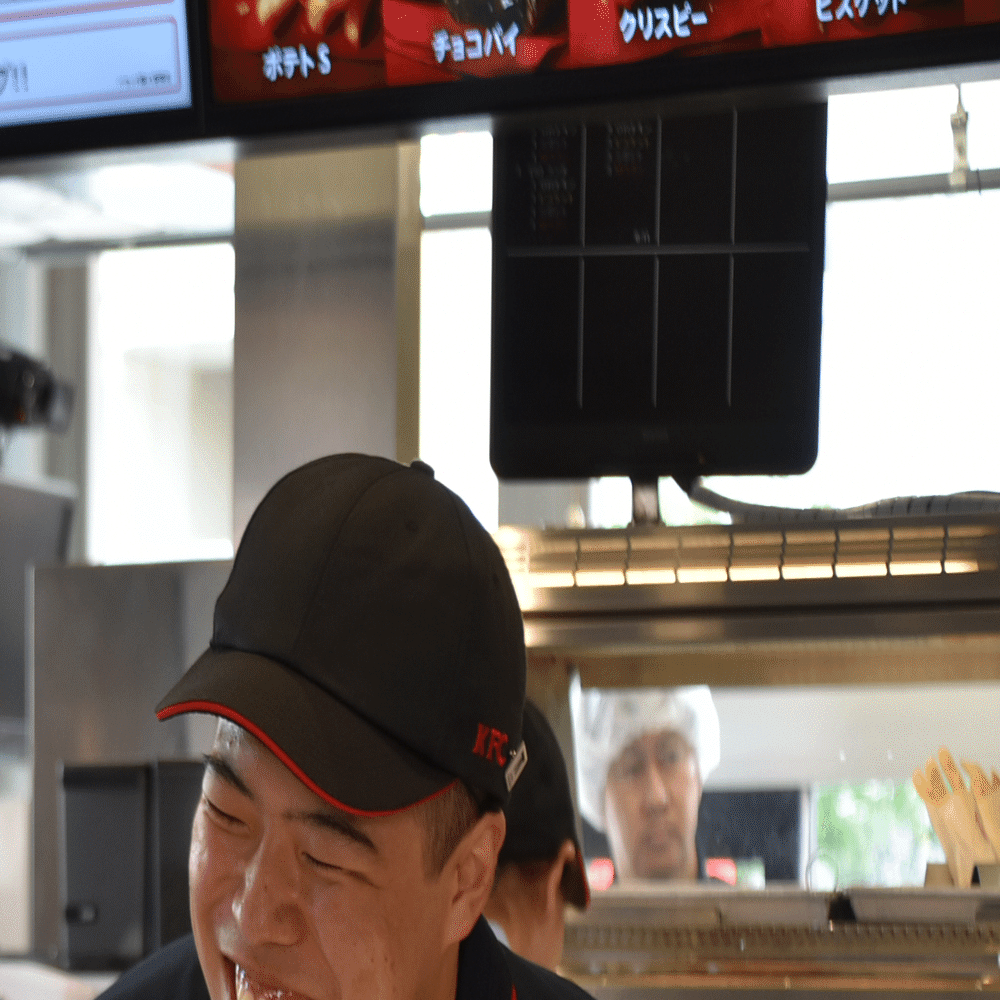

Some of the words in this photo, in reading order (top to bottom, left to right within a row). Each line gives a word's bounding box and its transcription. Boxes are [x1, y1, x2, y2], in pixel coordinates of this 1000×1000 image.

[619, 1, 708, 43] クリスピー
[472, 722, 509, 768] KFC
